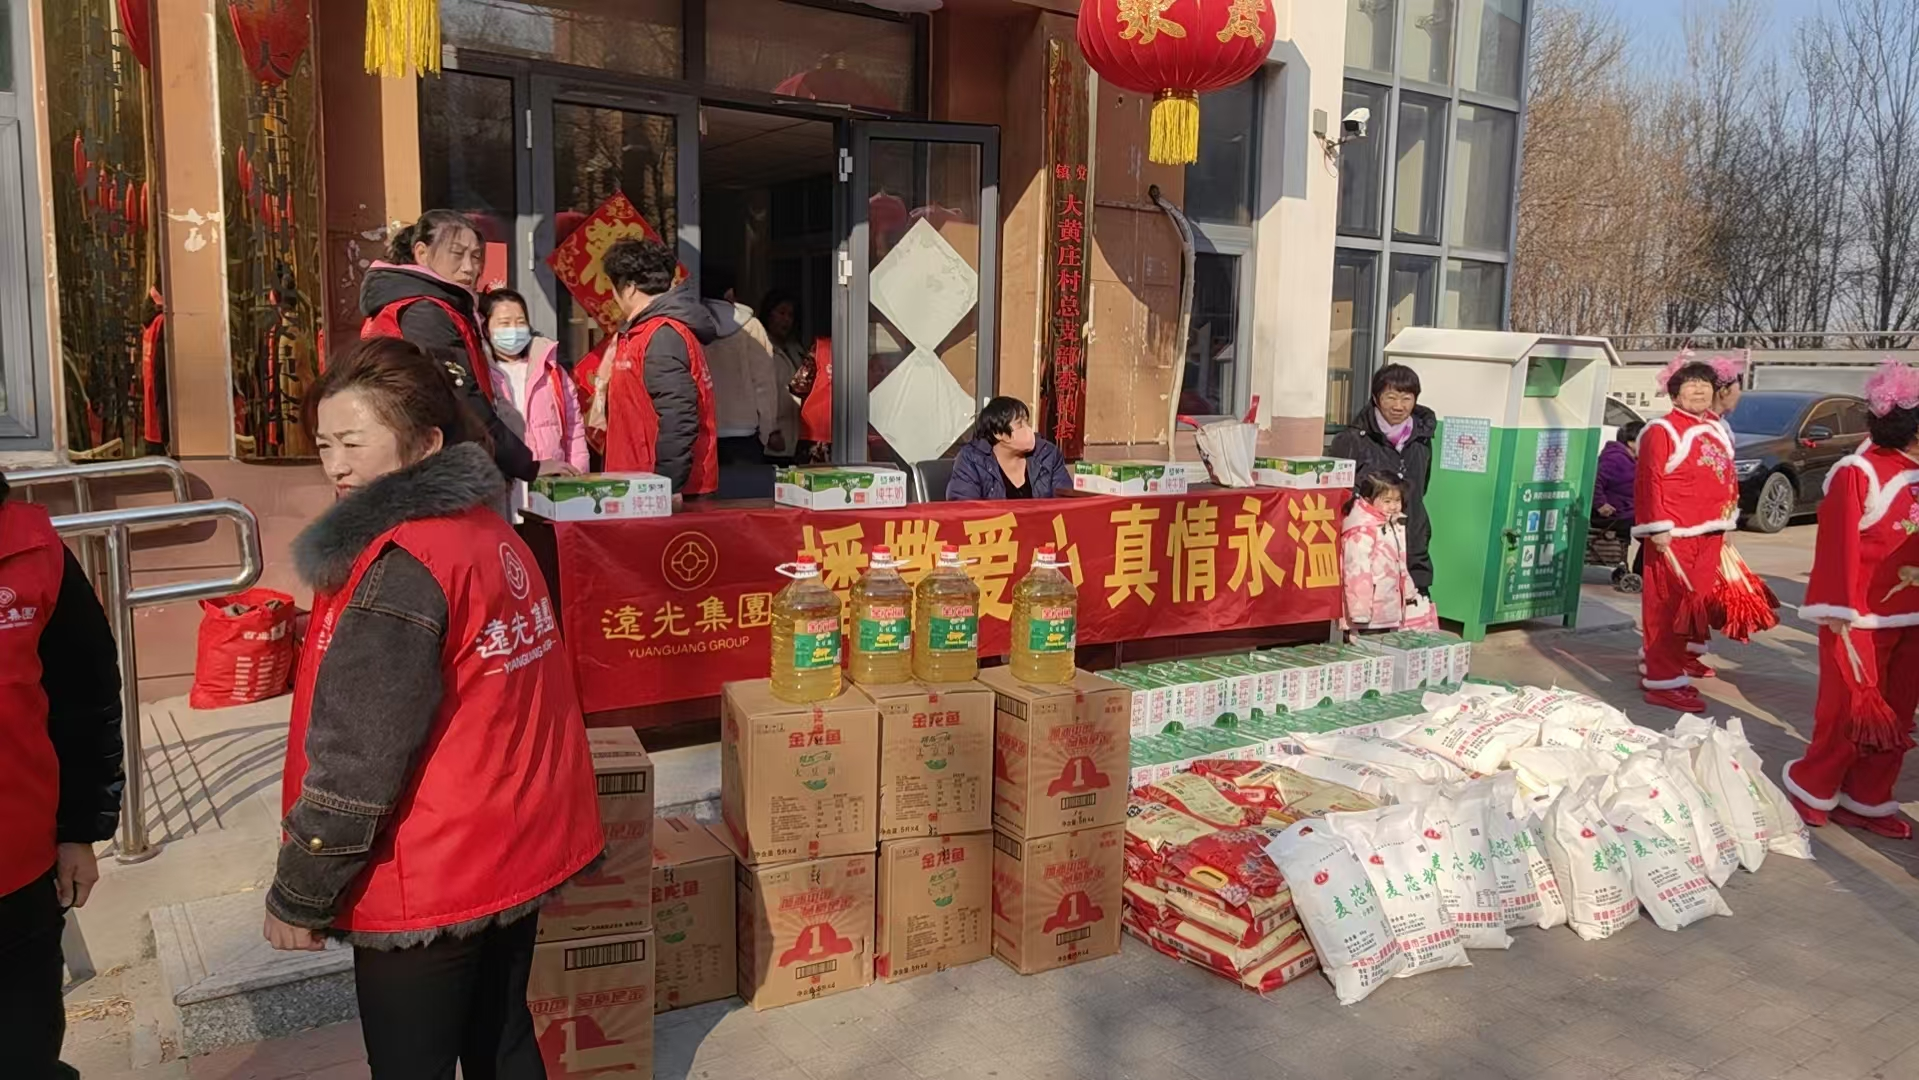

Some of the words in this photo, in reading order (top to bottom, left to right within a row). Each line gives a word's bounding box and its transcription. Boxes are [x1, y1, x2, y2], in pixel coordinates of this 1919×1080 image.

[628, 641, 706, 659] YUANGUANG
[709, 635, 750, 651] GROUP
[912, 711, 960, 728] 金龙鱼
[1072, 759, 1085, 786] 1
[921, 848, 965, 870] 金龙鱼
[1068, 895, 1080, 921] 1
[809, 926, 825, 955] 1
